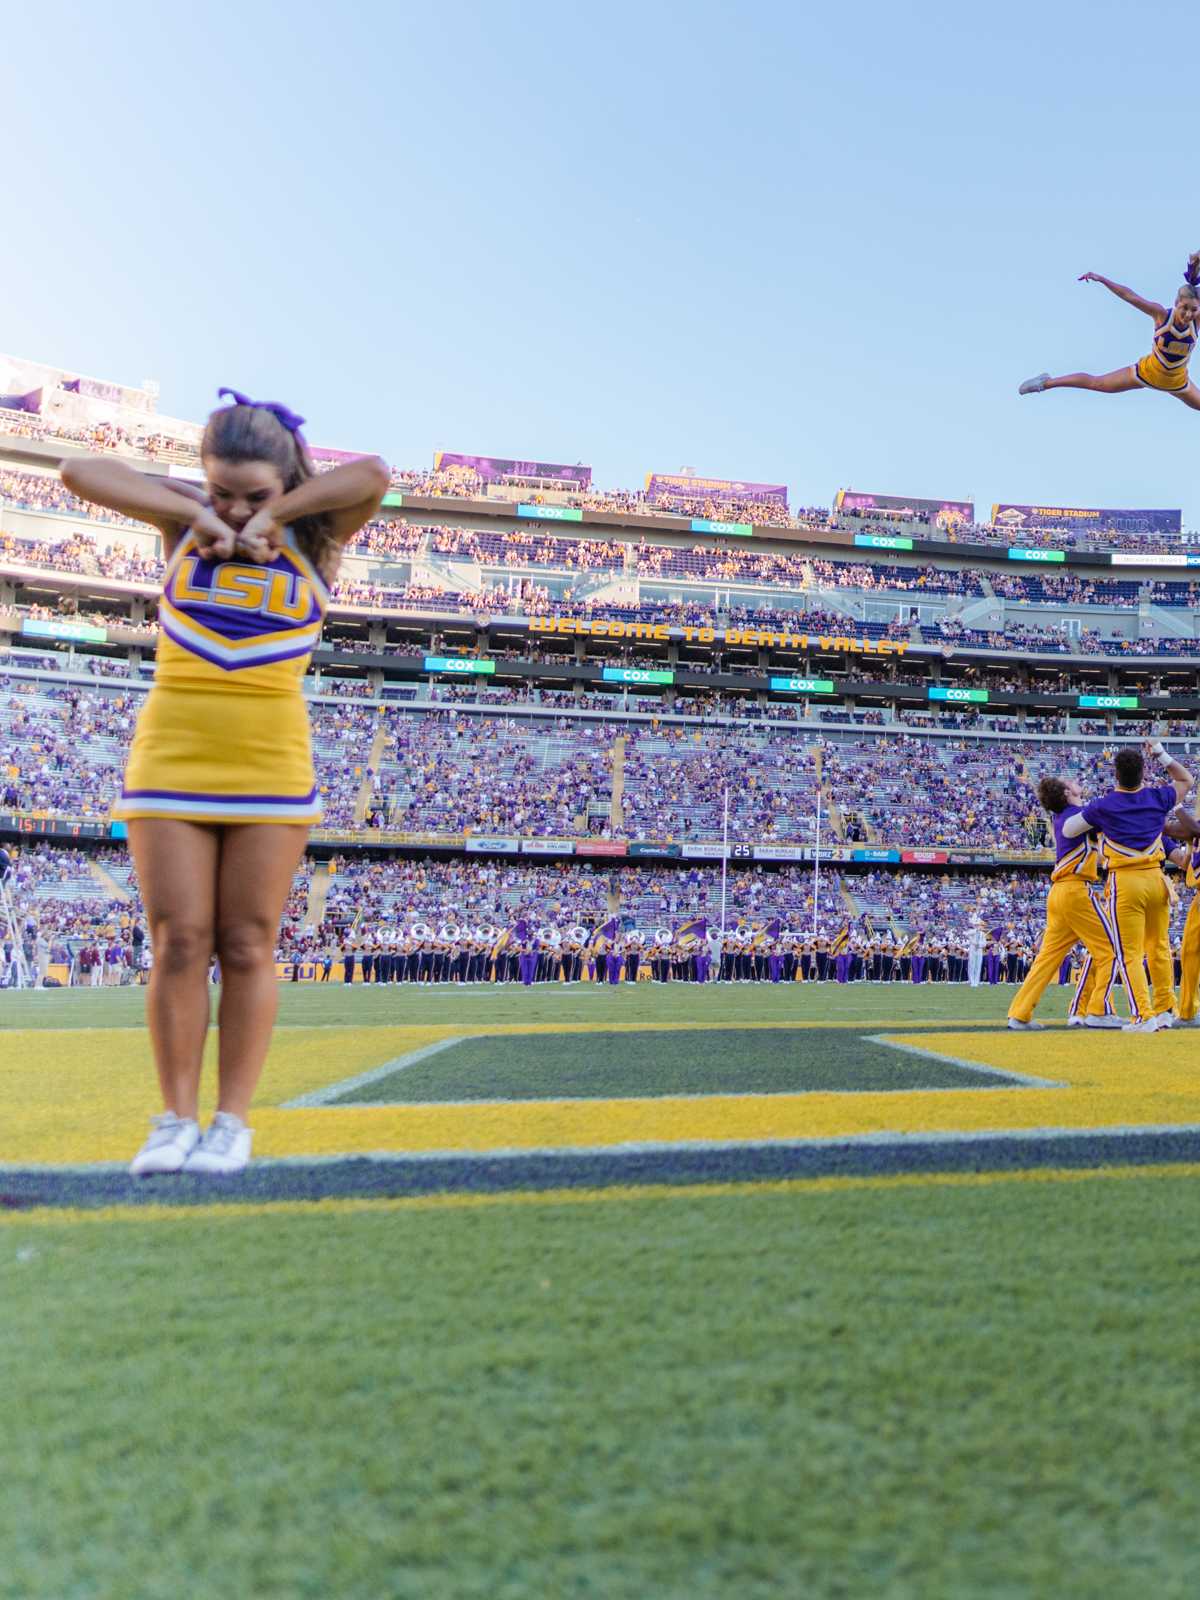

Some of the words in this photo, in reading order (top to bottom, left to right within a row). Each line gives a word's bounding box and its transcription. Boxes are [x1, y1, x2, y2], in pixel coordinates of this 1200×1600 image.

[536, 508, 564, 518] COX
[1039, 508, 1062, 517] TIGER
[1063, 509, 1100, 518] STADIUM
[709, 521, 735, 533] COX
[872, 537, 896, 548] COX
[1025, 551, 1048, 560] COX
[174, 556, 313, 623] LSU
[47, 623, 83, 637] COX
[529, 616, 670, 642] WELCOME
[682, 627, 715, 643] TO
[725, 629, 808, 649] DEATH
[819, 636, 910, 656] VALLEY
[445, 658, 475, 671] COX
[623, 670, 650, 682] COX
[789, 679, 816, 691] COX
[946, 689, 971, 701] COX
[1096, 697, 1121, 708] COX
[734, 844, 750, 857] 25
